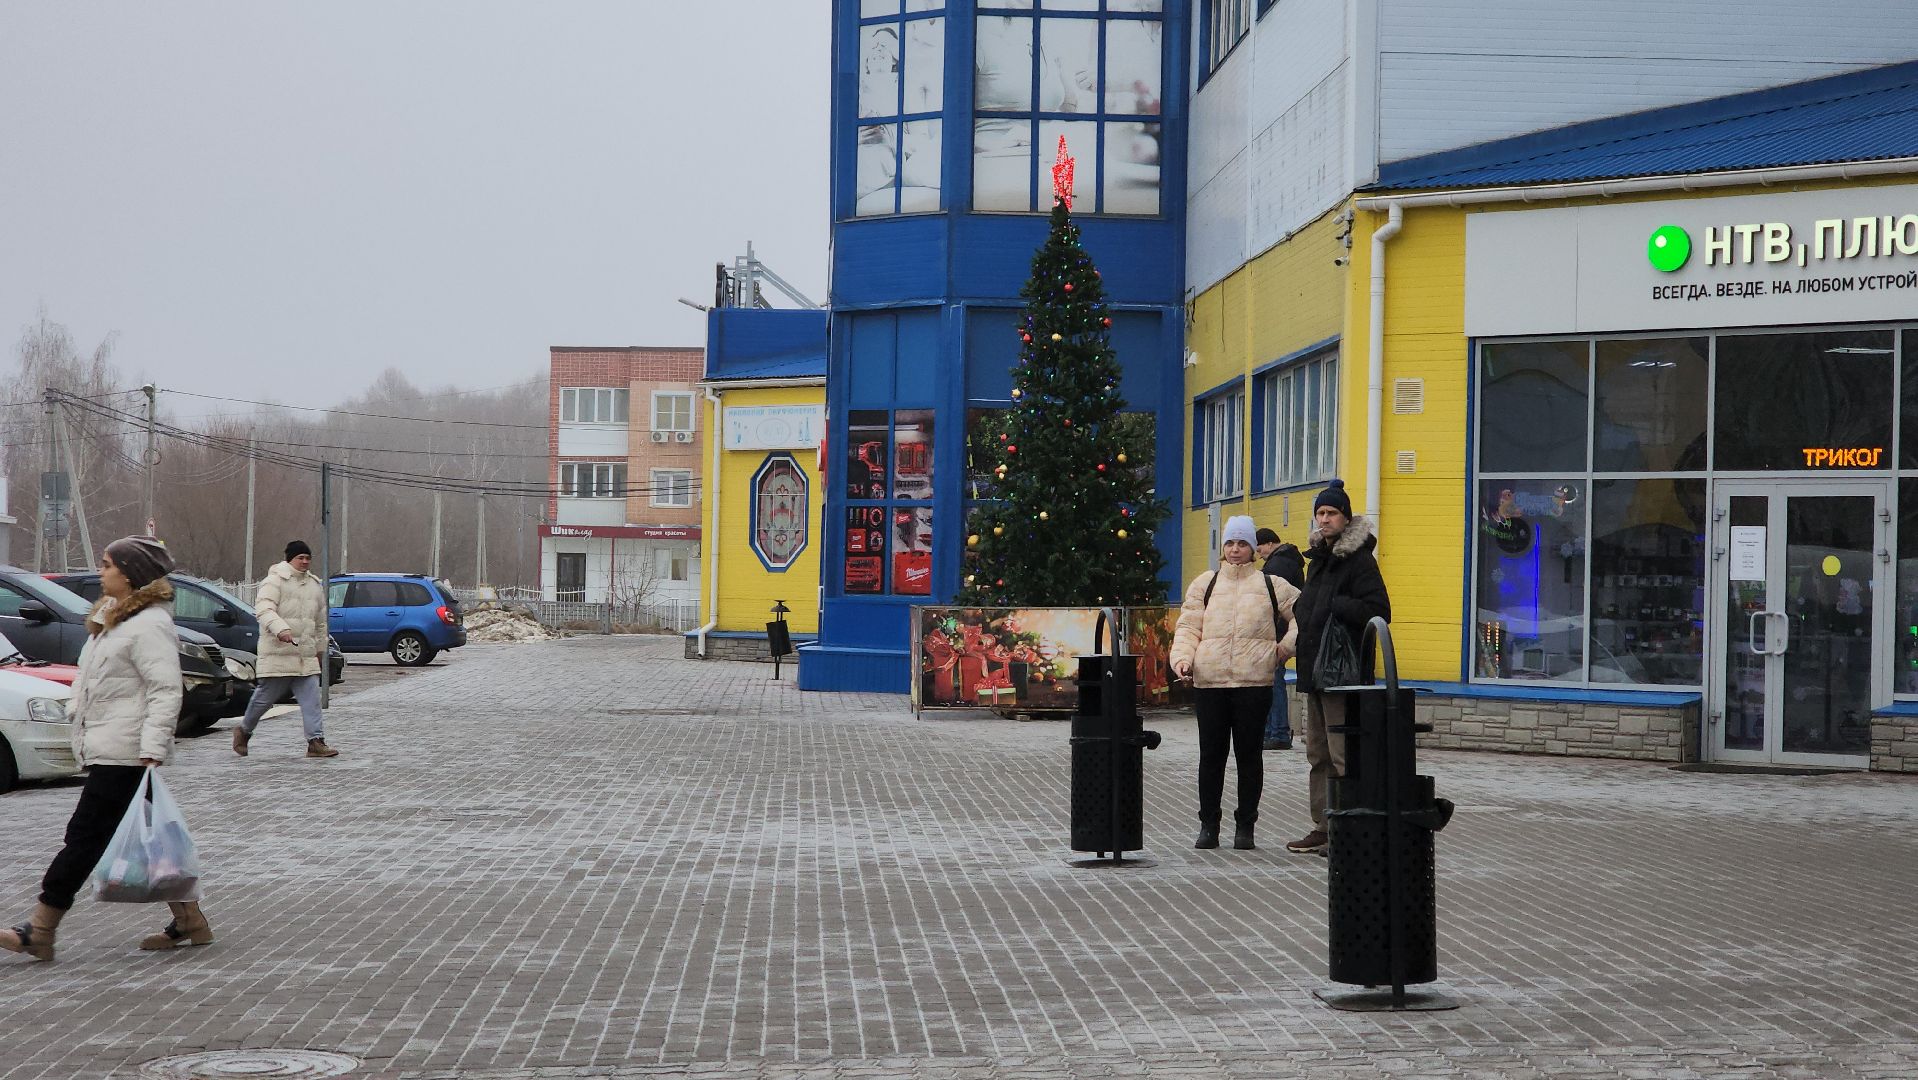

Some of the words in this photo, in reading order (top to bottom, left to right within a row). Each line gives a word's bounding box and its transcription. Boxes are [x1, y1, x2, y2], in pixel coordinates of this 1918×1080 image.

[1652, 283, 1712, 302] ВСЕГДА.
[1715, 280, 1768, 299] ВЕЗДЕ.
[1771, 280, 1793, 295] НА
[1795, 276, 1855, 294] ЛЮБОМ
[1857, 270, 1918, 292] УСТРОЙ
